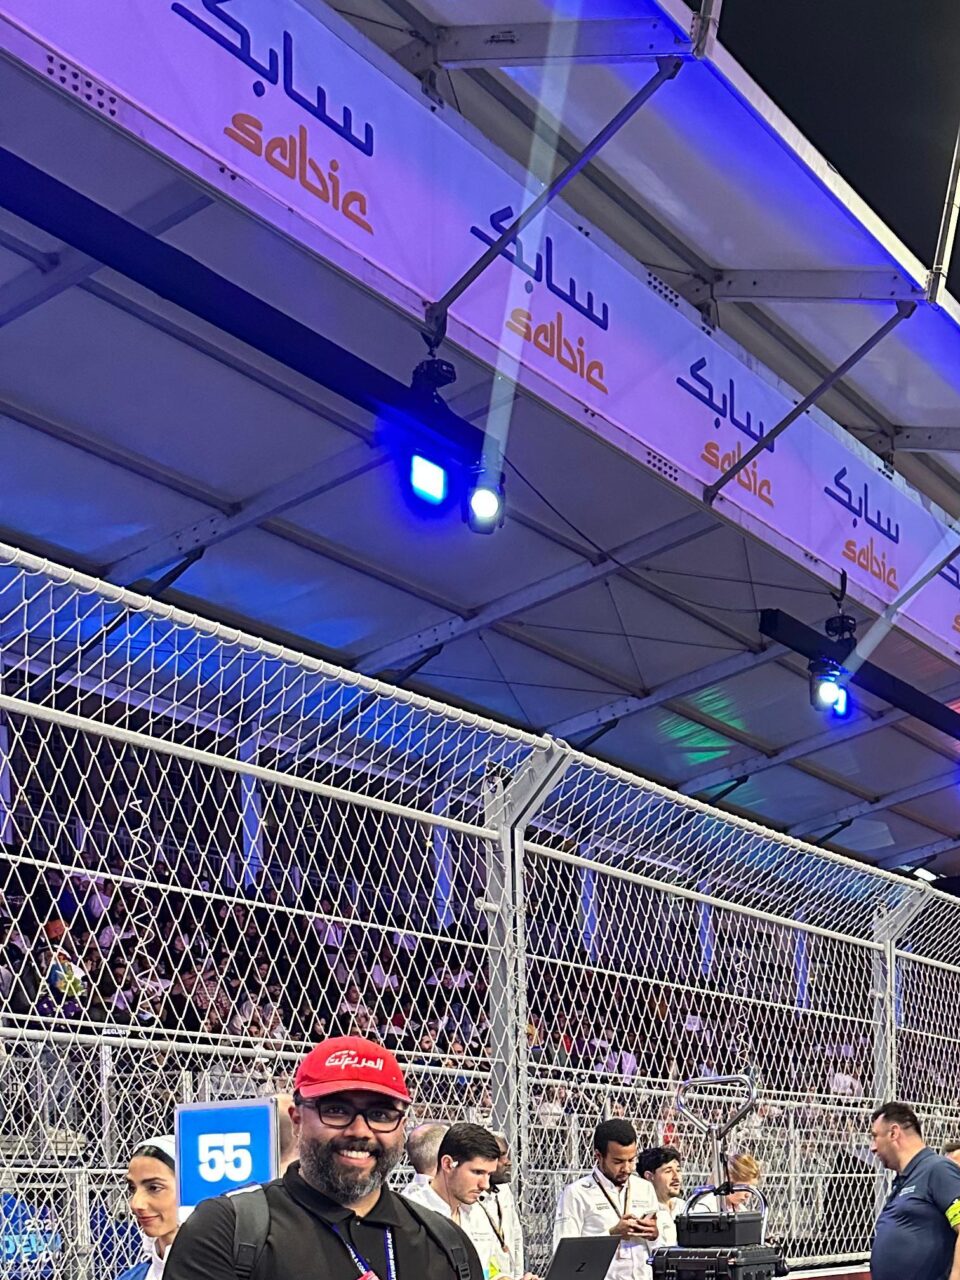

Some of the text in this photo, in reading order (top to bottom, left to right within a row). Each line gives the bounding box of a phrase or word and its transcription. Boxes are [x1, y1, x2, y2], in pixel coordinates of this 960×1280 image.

[223, 111, 375, 236] sabic
[505, 307, 609, 395] sabic
[701, 440, 775, 507] sabic
[823, 466, 900, 544] سابك
[841, 537, 900, 592] sabic
[197, 1132, 253, 1183] 55
